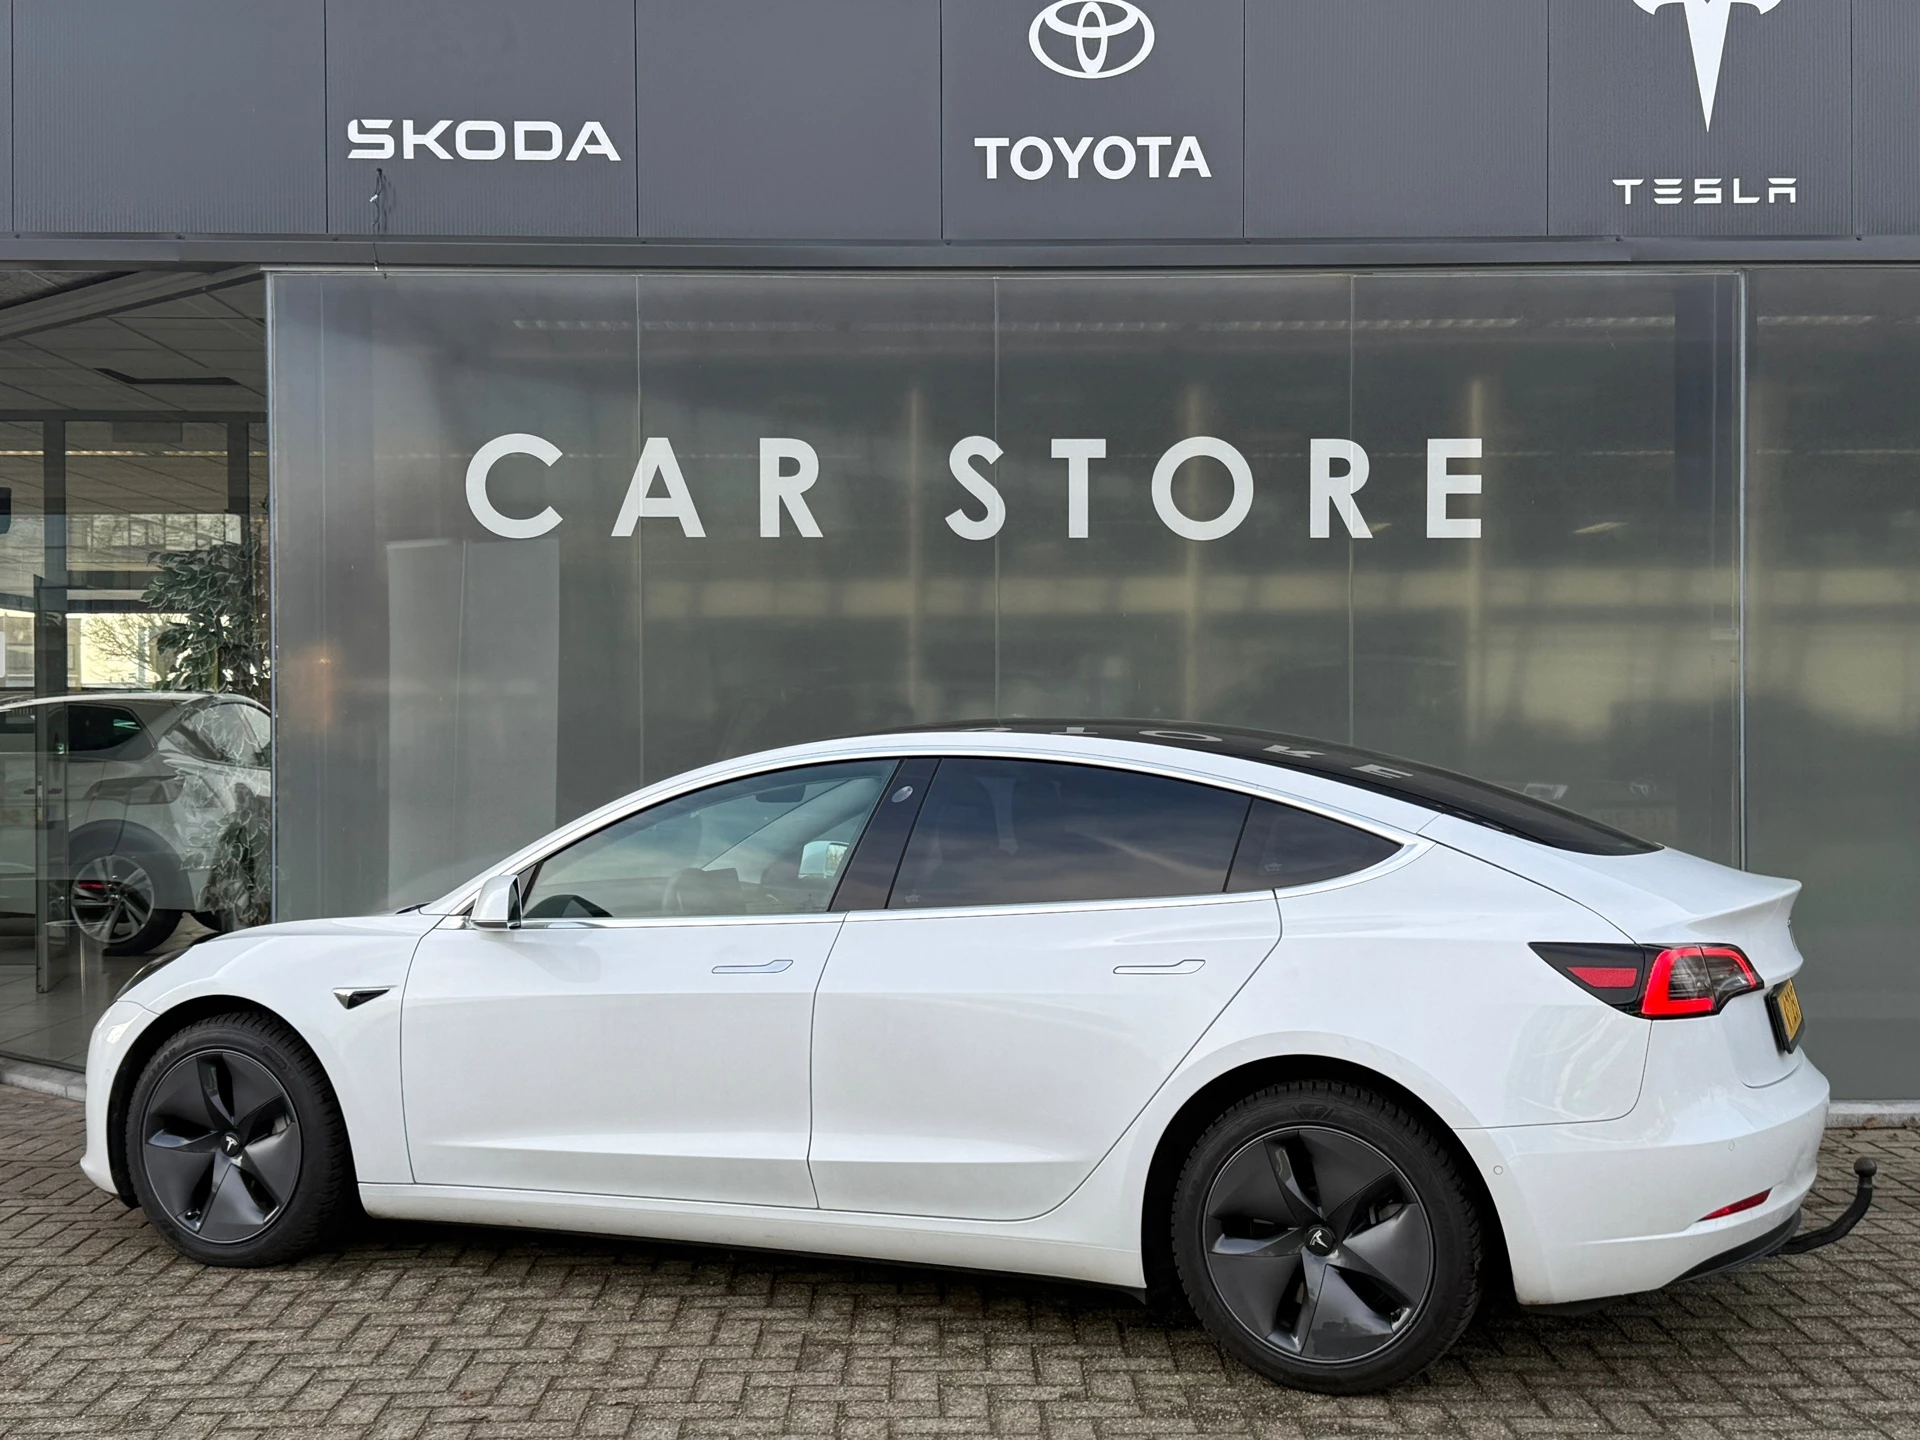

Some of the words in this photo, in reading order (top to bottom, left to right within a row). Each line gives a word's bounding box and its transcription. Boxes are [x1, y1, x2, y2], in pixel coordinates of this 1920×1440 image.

[348, 119, 622, 162] SKODA
[974, 135, 1212, 181] TOYOTA
[1612, 177, 1797, 205] TESLA
[466, 434, 823, 538] CAR
[945, 436, 1483, 540] STORE
